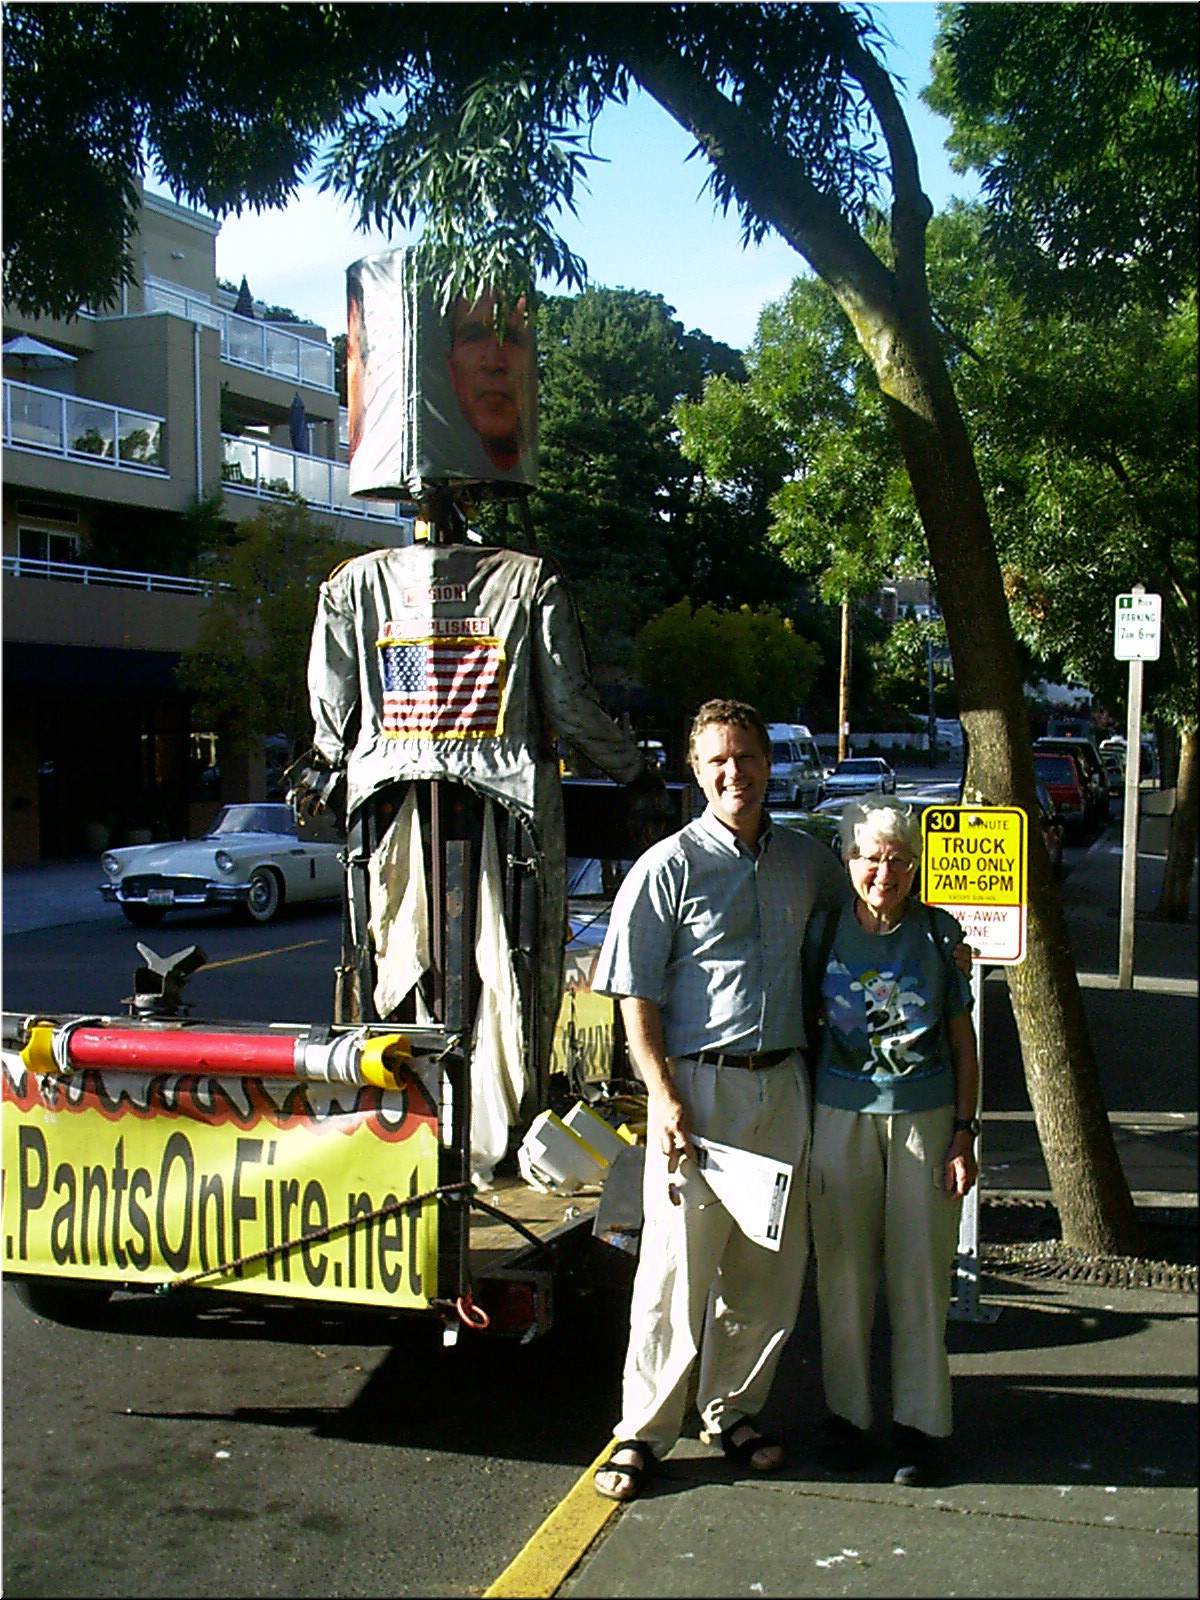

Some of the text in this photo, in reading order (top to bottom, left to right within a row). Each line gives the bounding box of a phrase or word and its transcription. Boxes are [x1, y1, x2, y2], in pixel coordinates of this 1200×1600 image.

[384, 620, 487, 635] ACPLISHED
[930, 811, 1009, 831] 30 NUTE
[942, 837, 1006, 855] TRUCK
[931, 857, 1016, 873] LOAD ONLY
[934, 874, 1014, 892] 7AM-6PM
[949, 909, 1008, 923] W-AWAY
[963, 925, 990, 938] ONE
[2, 1124, 423, 1296] .PantsOnFire.net
